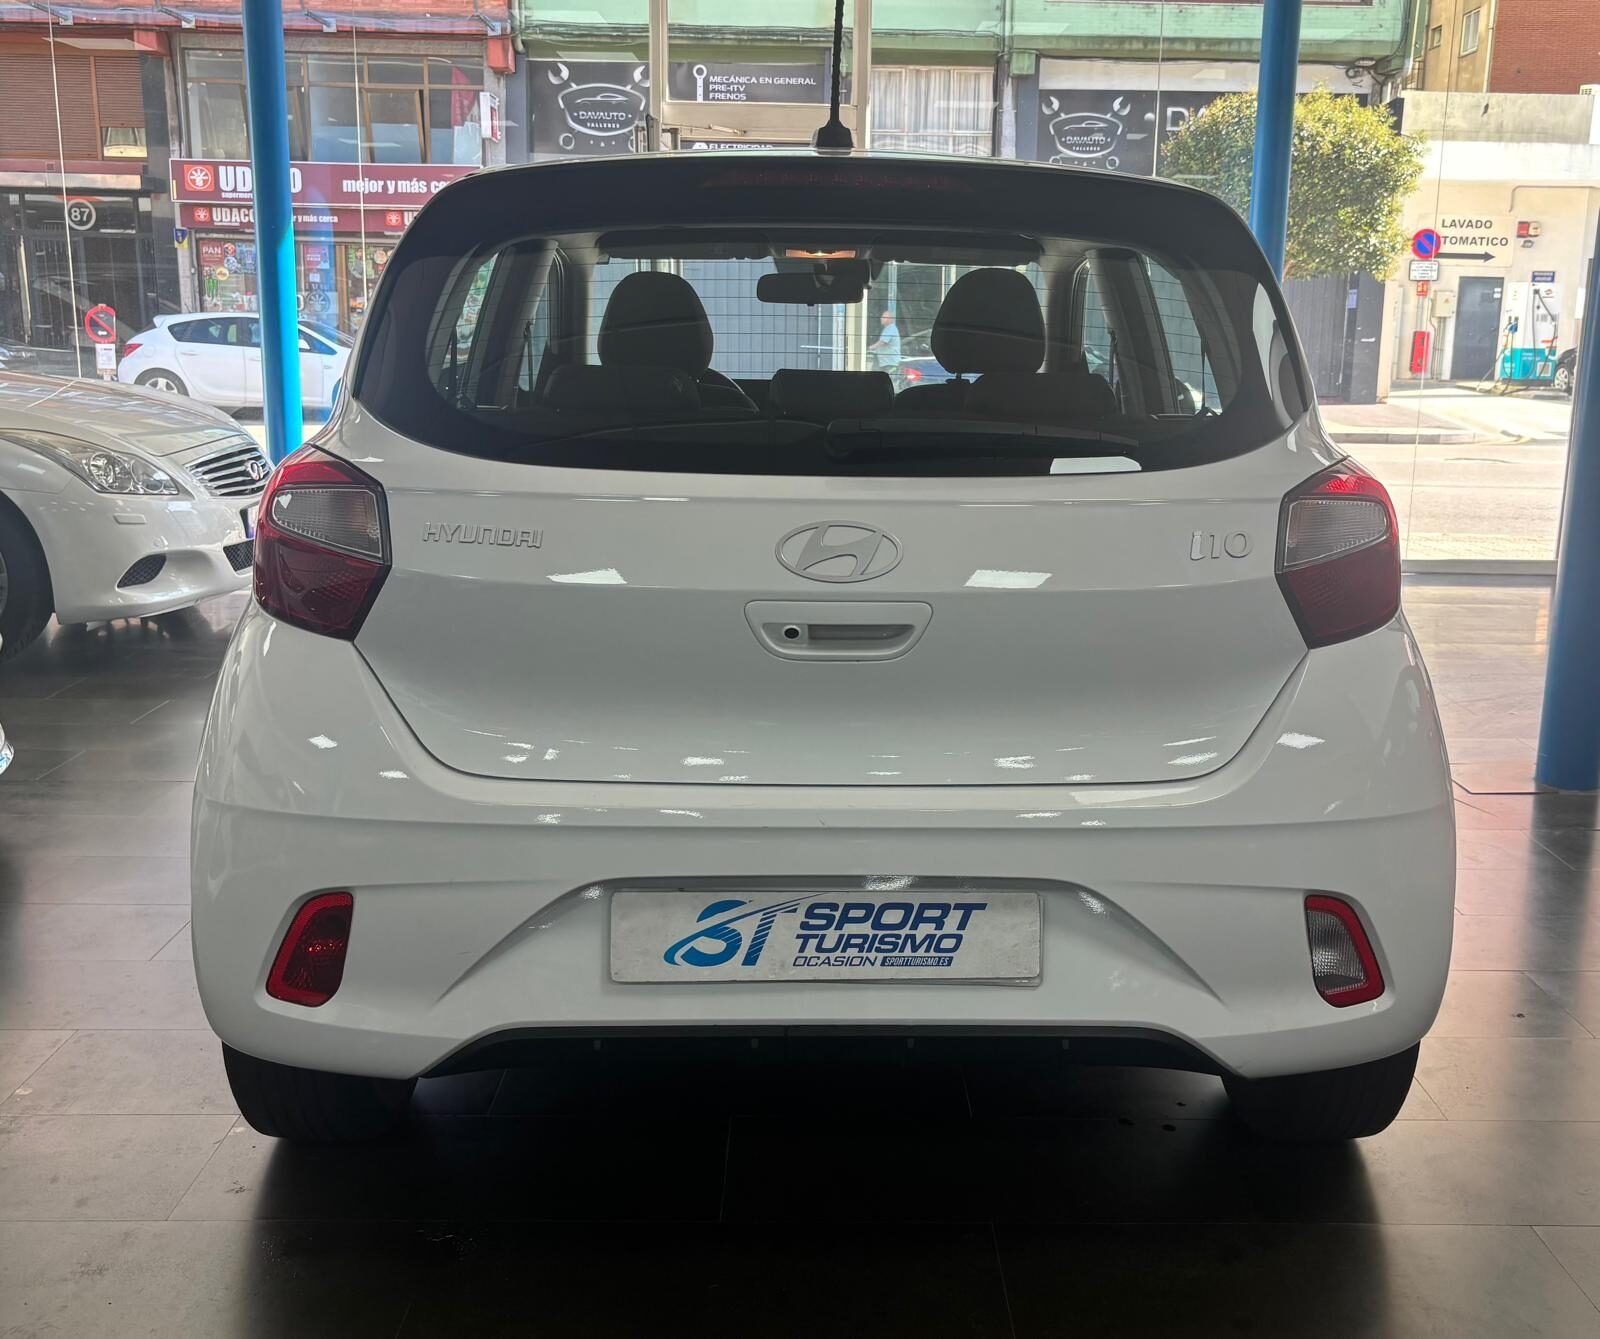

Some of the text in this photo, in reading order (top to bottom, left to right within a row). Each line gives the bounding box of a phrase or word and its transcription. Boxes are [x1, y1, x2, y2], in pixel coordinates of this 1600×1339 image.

[709, 75, 758, 84] MECÁNICA
[774, 77, 817, 86] GENERAL
[709, 84, 746, 92] PRE-ITV
[709, 92, 747, 101] FRENOS
[579, 111, 626, 120] DAVAUTO
[342, 177, 385, 193] mejor
[386, 180, 399, 194] y
[397, 178, 428, 193] más
[70, 207, 90, 222] 87
[1441, 219, 1493, 229] LAVADO
[1440, 235, 1509, 247] TOMATICO
[202, 246, 221, 254] PAN
[422, 521, 544, 549] HYUNDAI
[799, 902, 988, 932] SPORT
[795, 933, 963, 954] TURISMO
[792, 955, 949, 967] OCASION SPORTTURISMO.ES
